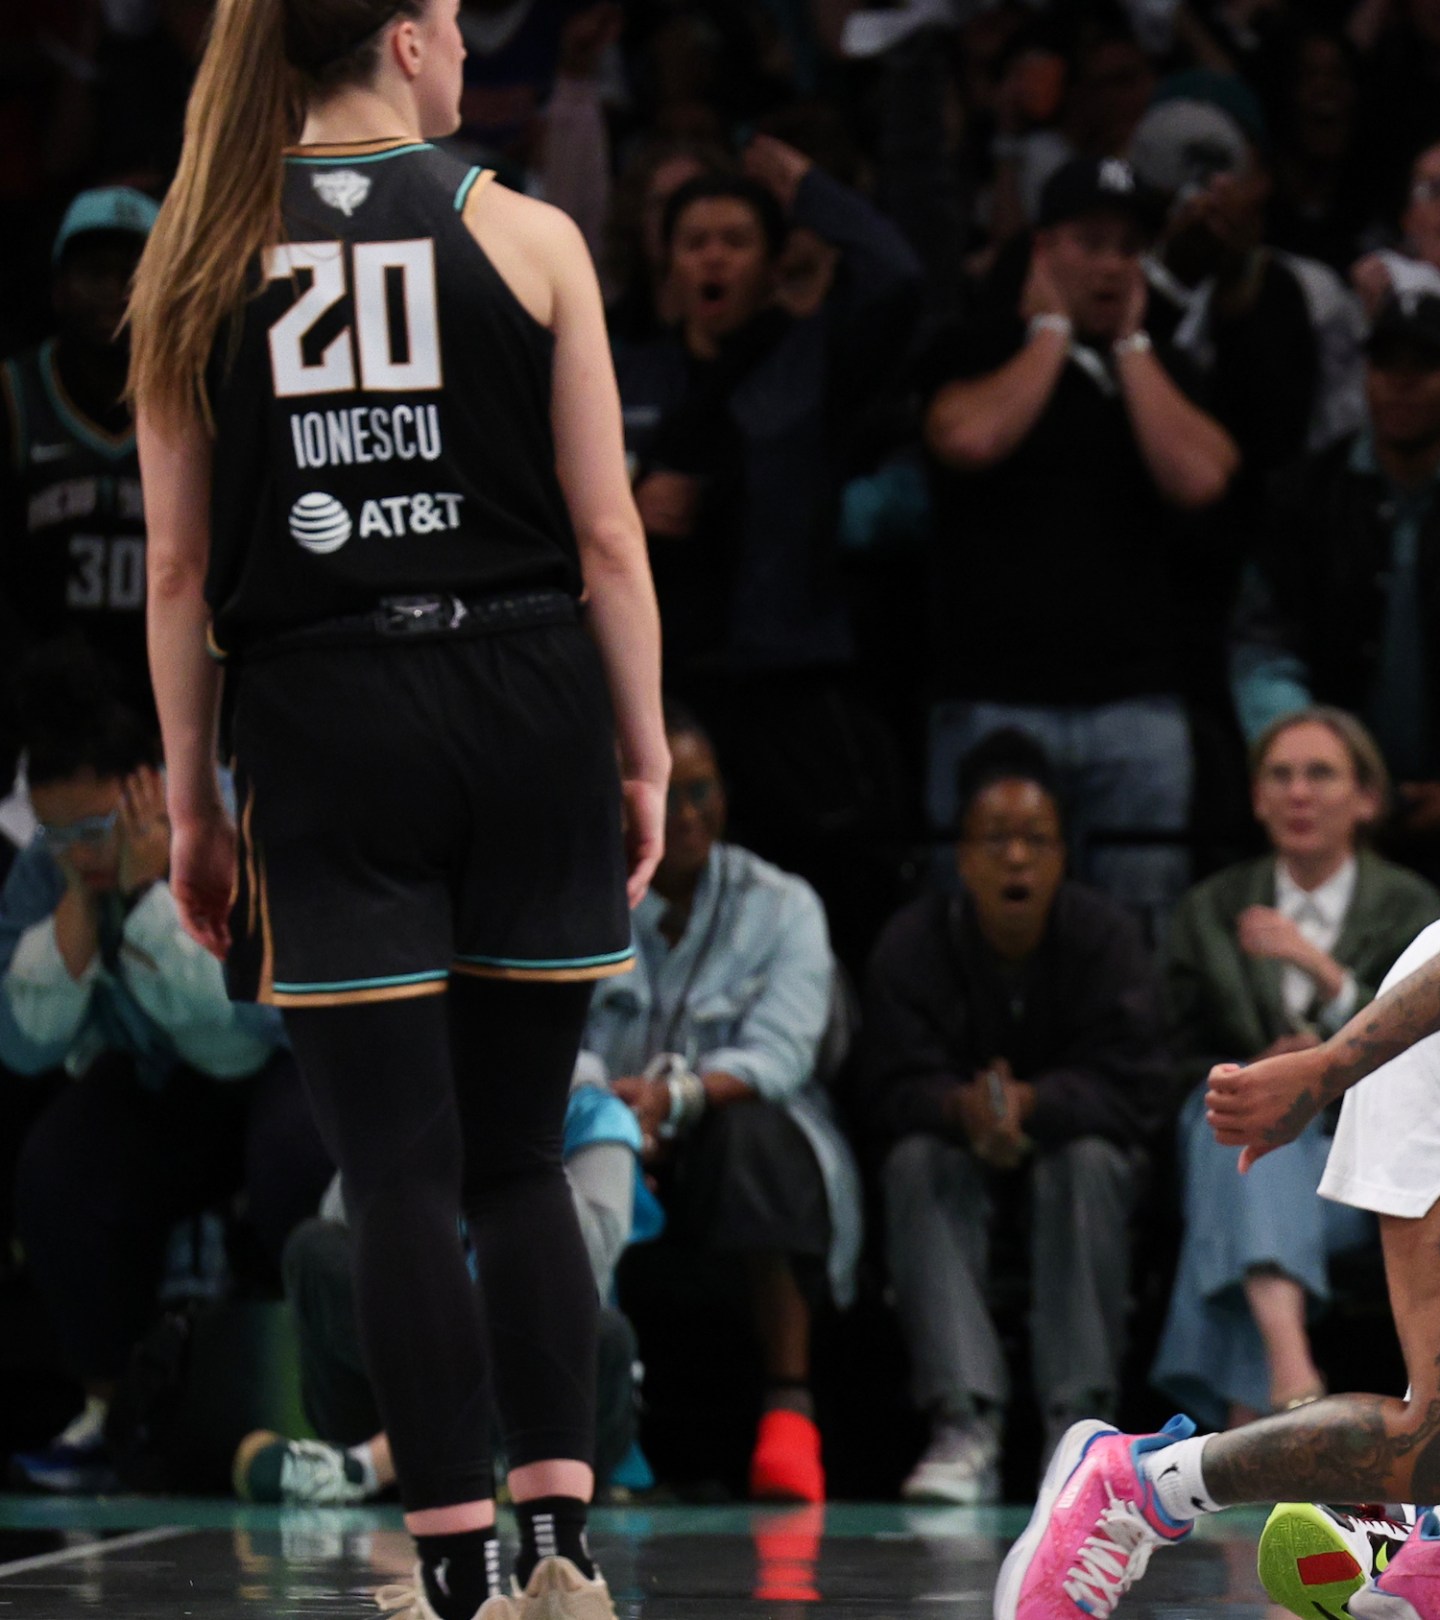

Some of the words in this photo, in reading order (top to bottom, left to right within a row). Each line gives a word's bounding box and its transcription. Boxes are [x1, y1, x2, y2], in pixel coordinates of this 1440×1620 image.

[260, 237, 444, 398] 20
[289, 403, 442, 470] IONESCU
[359, 491, 466, 539] AT&T
[64, 532, 146, 612] 30
